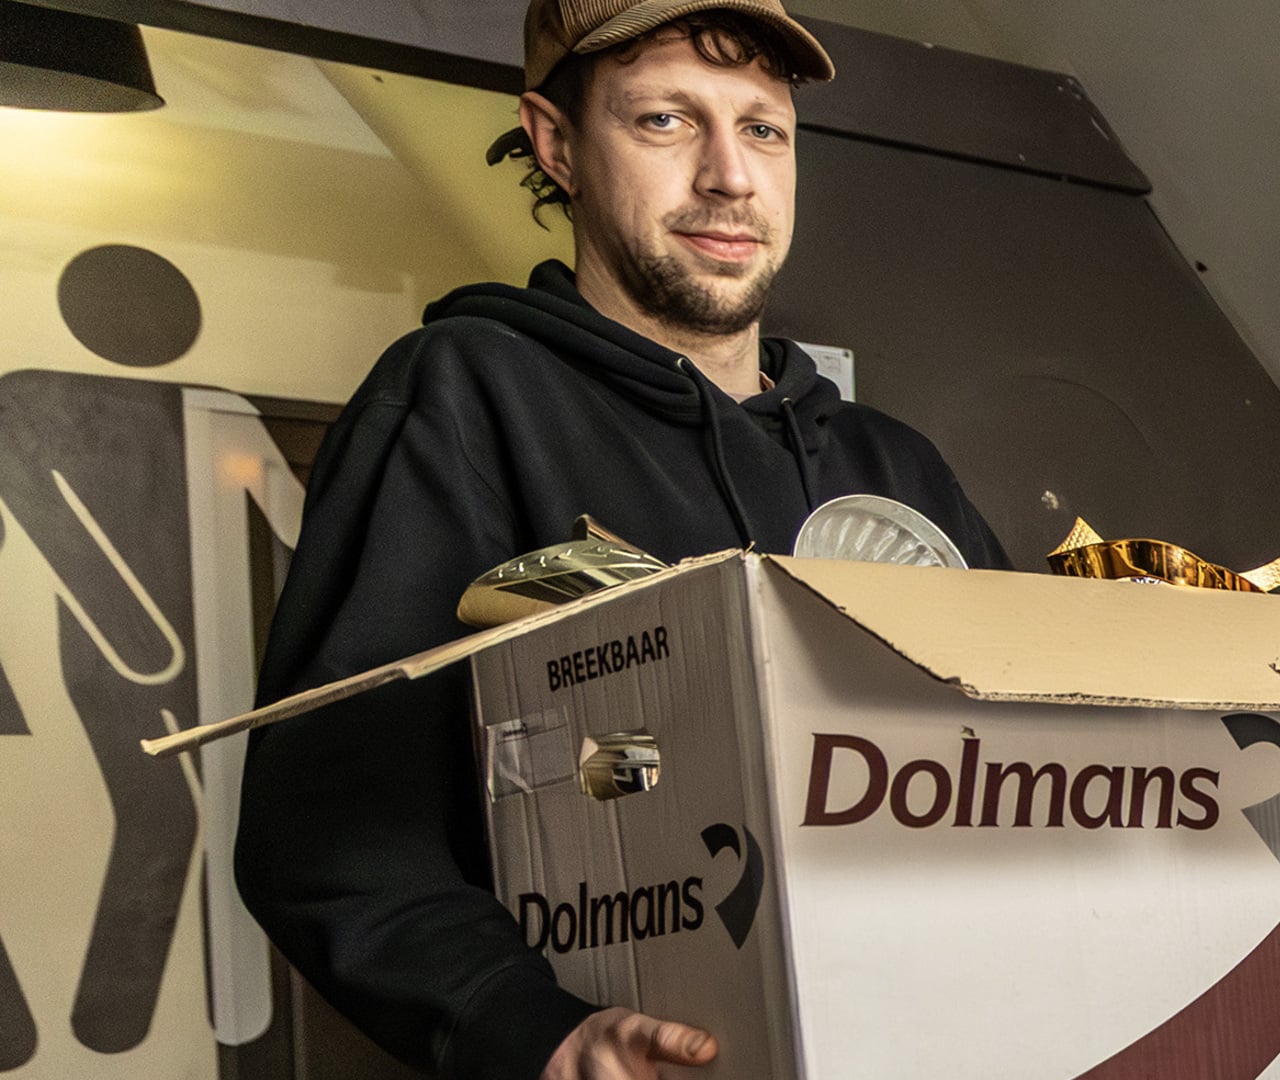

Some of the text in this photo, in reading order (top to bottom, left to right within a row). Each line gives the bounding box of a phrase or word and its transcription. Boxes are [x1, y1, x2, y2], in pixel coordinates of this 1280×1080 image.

[547, 626, 670, 691] BREEKBAAR
[800, 732, 1221, 830] Dolmans
[518, 876, 705, 954] Dolmans
